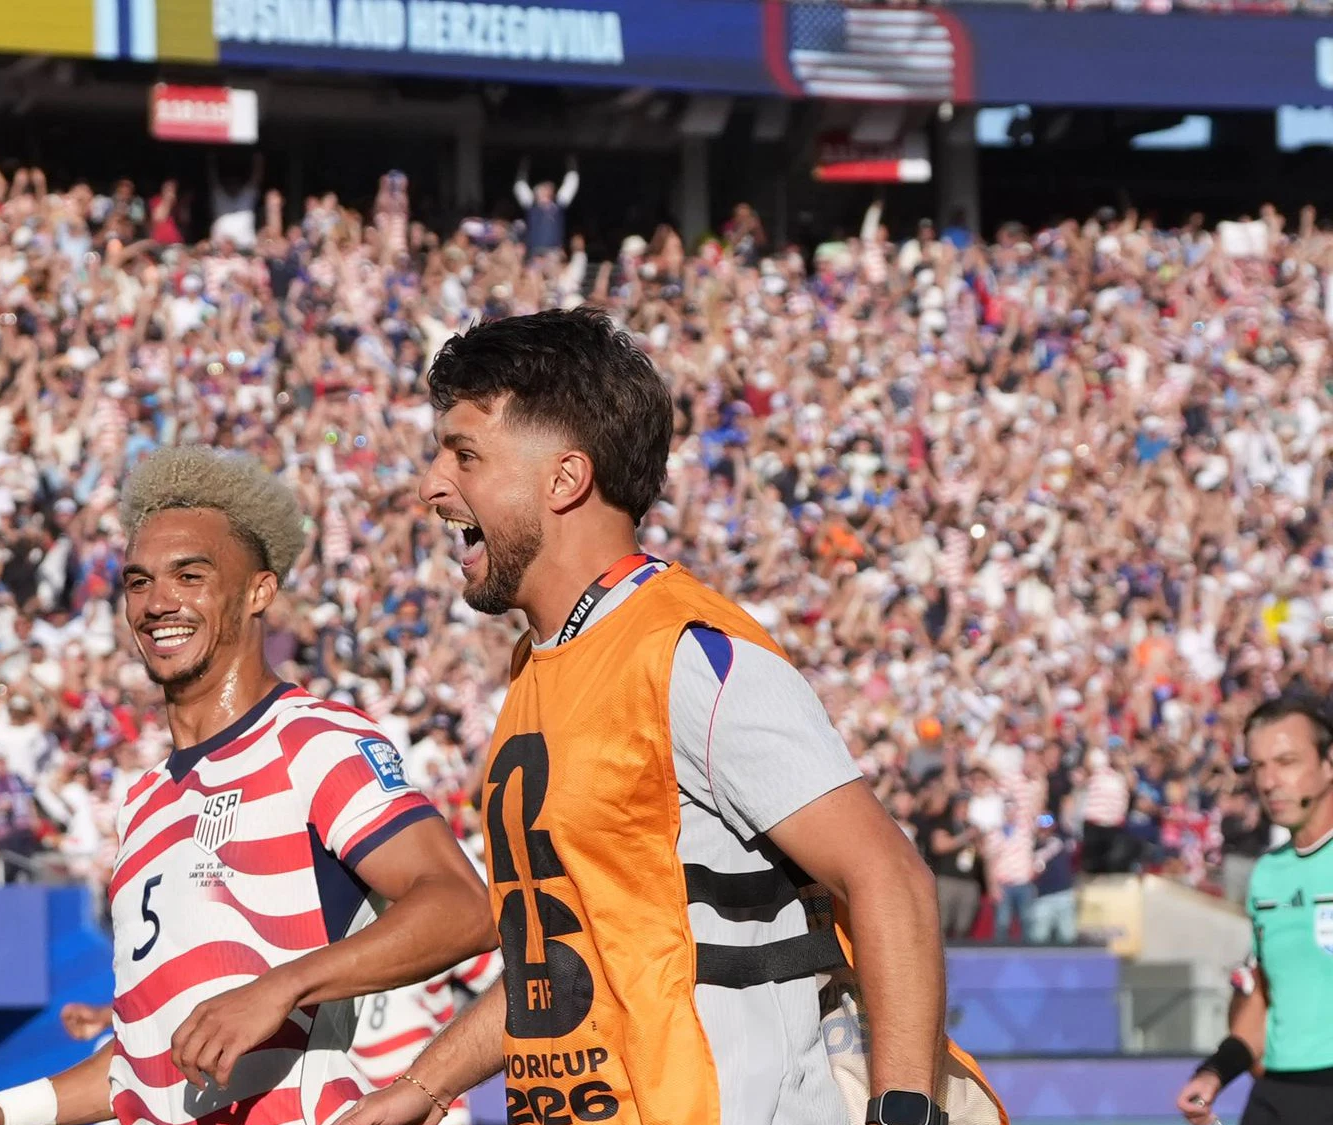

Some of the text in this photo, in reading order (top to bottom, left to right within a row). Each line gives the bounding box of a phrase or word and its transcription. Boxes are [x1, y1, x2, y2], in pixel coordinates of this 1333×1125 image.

[335, 0, 405, 51] AND
[407, 0, 624, 65] HERZEGOVINA
[561, 594, 594, 644] FIFA WO
[203, 793, 238, 817] USA
[132, 873, 163, 961] 5
[370, 994, 387, 1030] 8
